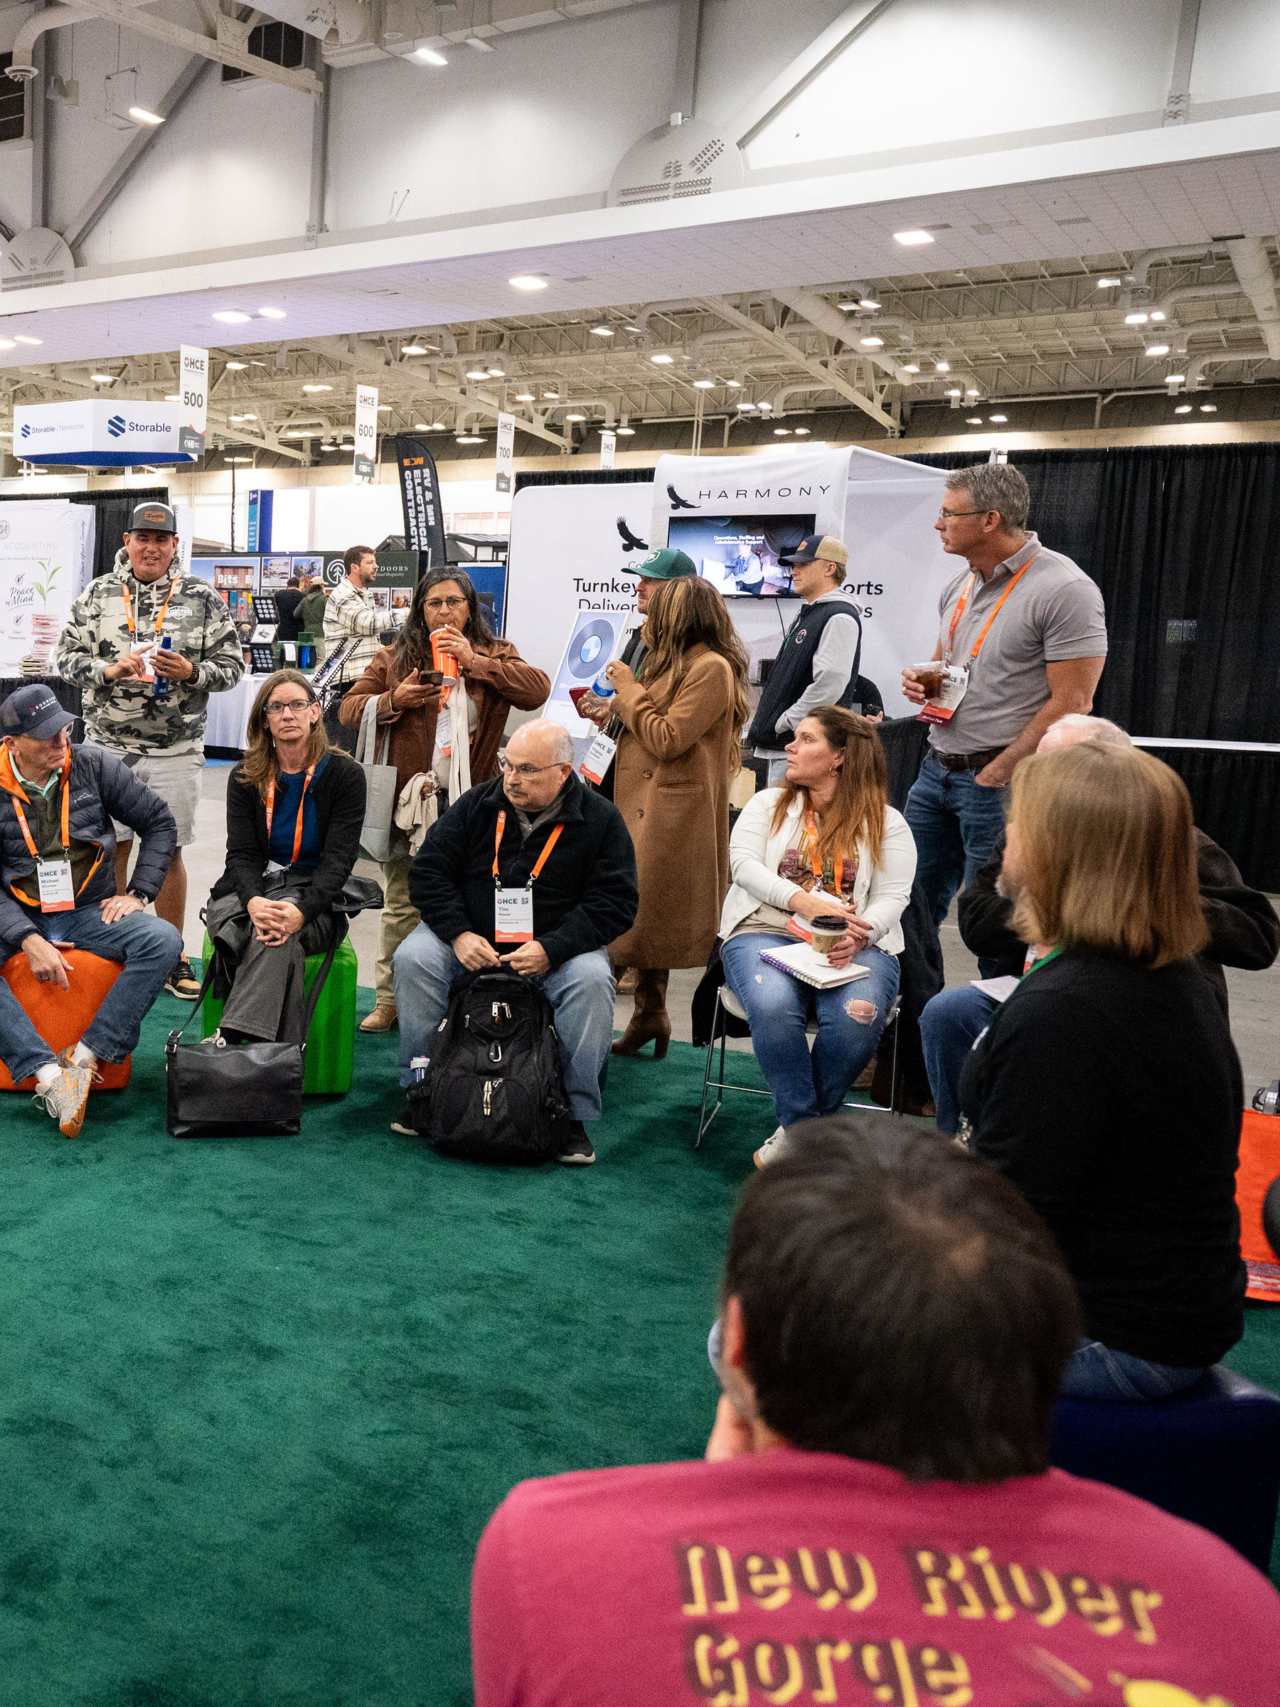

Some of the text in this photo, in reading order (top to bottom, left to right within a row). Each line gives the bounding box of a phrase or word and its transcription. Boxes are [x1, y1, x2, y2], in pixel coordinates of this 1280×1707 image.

[184, 356, 205, 371] OHCE
[184, 391, 203, 408] 500
[129, 422, 172, 433] Storable
[358, 424, 373, 438] 600
[500, 447, 510, 458] 700
[422, 468, 431, 487] RV
[425, 491, 433, 502] &
[698, 484, 831, 499] HARMONY
[4, 542, 59, 550] ACCOUNTING
[10, 587, 34, 597] Peace
[573, 577, 638, 597] Turnkey
[678, 1542, 1163, 1645] New River
[686, 1627, 974, 1707] Gorge
